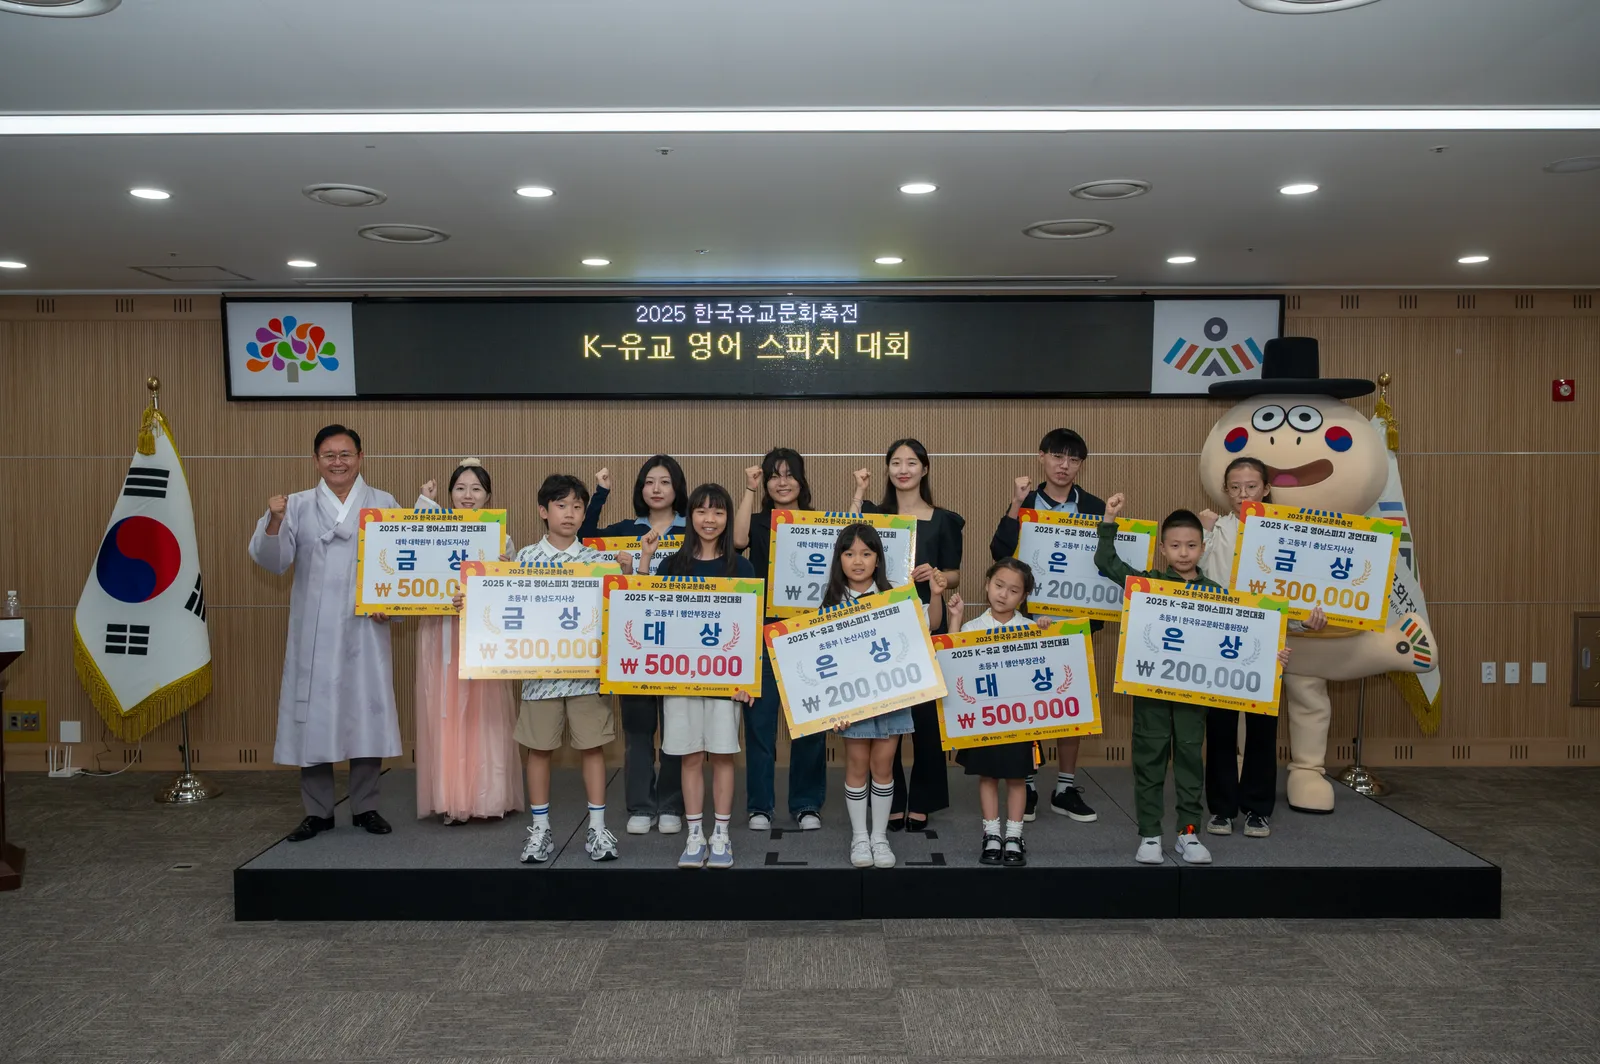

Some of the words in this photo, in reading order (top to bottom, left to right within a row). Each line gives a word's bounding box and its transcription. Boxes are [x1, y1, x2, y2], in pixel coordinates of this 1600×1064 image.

[636, 305, 686, 323] 2025
[694, 303, 858, 324] 한국유교문화축전
[584, 332, 675, 360] K-유교
[688, 331, 741, 360] 영어
[757, 331, 839, 360] 스피치
[856, 331, 910, 360] 대회
[1055, 528, 1076, 536] K-유교
[1260, 520, 1282, 530] 2025
[1284, 523, 1308, 534] K-유교
[1310, 526, 1346, 538] 영어스피치
[1348, 532, 1377, 543] 경연대회
[1305, 515, 1353, 527] 한국유교문화축전
[396, 550, 417, 570] 금
[448, 549, 468, 570] 상
[1313, 542, 1354, 554] 충남도지사상
[806, 553, 826, 575] 은
[1048, 552, 1068, 573] 은
[1274, 548, 1296, 572] 금
[1330, 556, 1353, 580] 상
[397, 578, 458, 600] 500,0
[648, 594, 673, 602] K-유교
[676, 595, 710, 603] 영어스피치
[714, 596, 742, 604] 경연대회
[1191, 592, 1240, 604] 한국유교문화축전
[1272, 578, 1370, 612] 300,000
[502, 607, 524, 630] 금
[558, 606, 580, 630] 상
[680, 610, 721, 618] 행안부장관상
[809, 616, 824, 625] 2025
[826, 602, 872, 620] 한국유교문화축전
[1146, 597, 1168, 606] 2025
[1170, 600, 1194, 610] K-유교
[1197, 604, 1234, 616] 영어스피치
[1236, 609, 1266, 620] 경연대회
[1159, 614, 1178, 623] 초등부
[644, 622, 666, 646] 대
[699, 622, 722, 646] 상
[787, 633, 808, 644] 2025
[810, 625, 834, 638] K-유교
[836, 615, 870, 634] 영어스피치
[872, 606, 900, 620] 경연대회
[994, 630, 1042, 641] 한국유교문화축전
[504, 638, 602, 662] 300,000
[818, 640, 838, 650] 초등부
[844, 629, 876, 644] 논산시장상
[952, 651, 973, 659] 2025
[976, 646, 1000, 656] K-유교
[1002, 642, 1038, 654] 영어스피치
[1040, 638, 1070, 648] 경연대회
[1162, 628, 1184, 652] 은
[1218, 635, 1242, 660] 상
[644, 654, 742, 678] 500,000
[816, 654, 838, 680] 은
[869, 637, 892, 662] 상
[978, 662, 998, 670] 초등부
[1004, 656, 1046, 668] 행안부장관상
[825, 663, 922, 708] 200,000
[975, 674, 998, 697] 대
[1032, 667, 1054, 692] 상
[1160, 658, 1261, 692] 200,000
[982, 696, 1080, 726] 500,000
